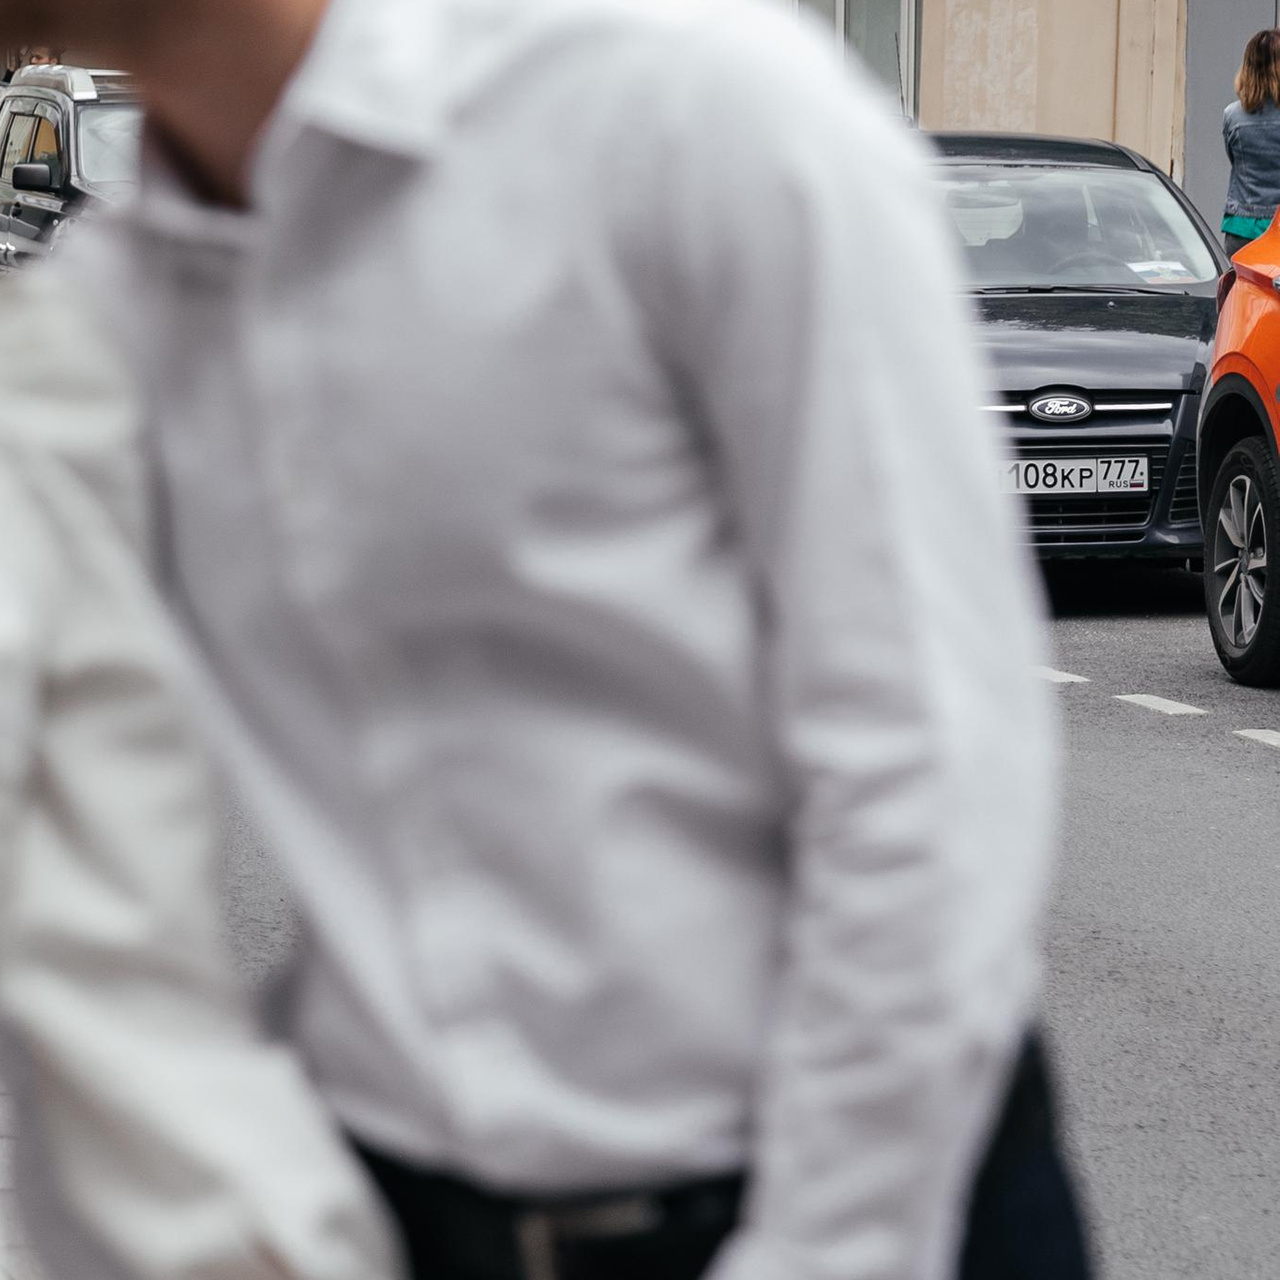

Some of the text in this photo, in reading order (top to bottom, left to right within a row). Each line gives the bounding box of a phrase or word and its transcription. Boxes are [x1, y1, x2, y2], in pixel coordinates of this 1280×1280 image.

[1045, 400, 1077, 415] Ford
[1001, 459, 1141, 489] 108КР 777
[1108, 480, 1129, 489] RUS
